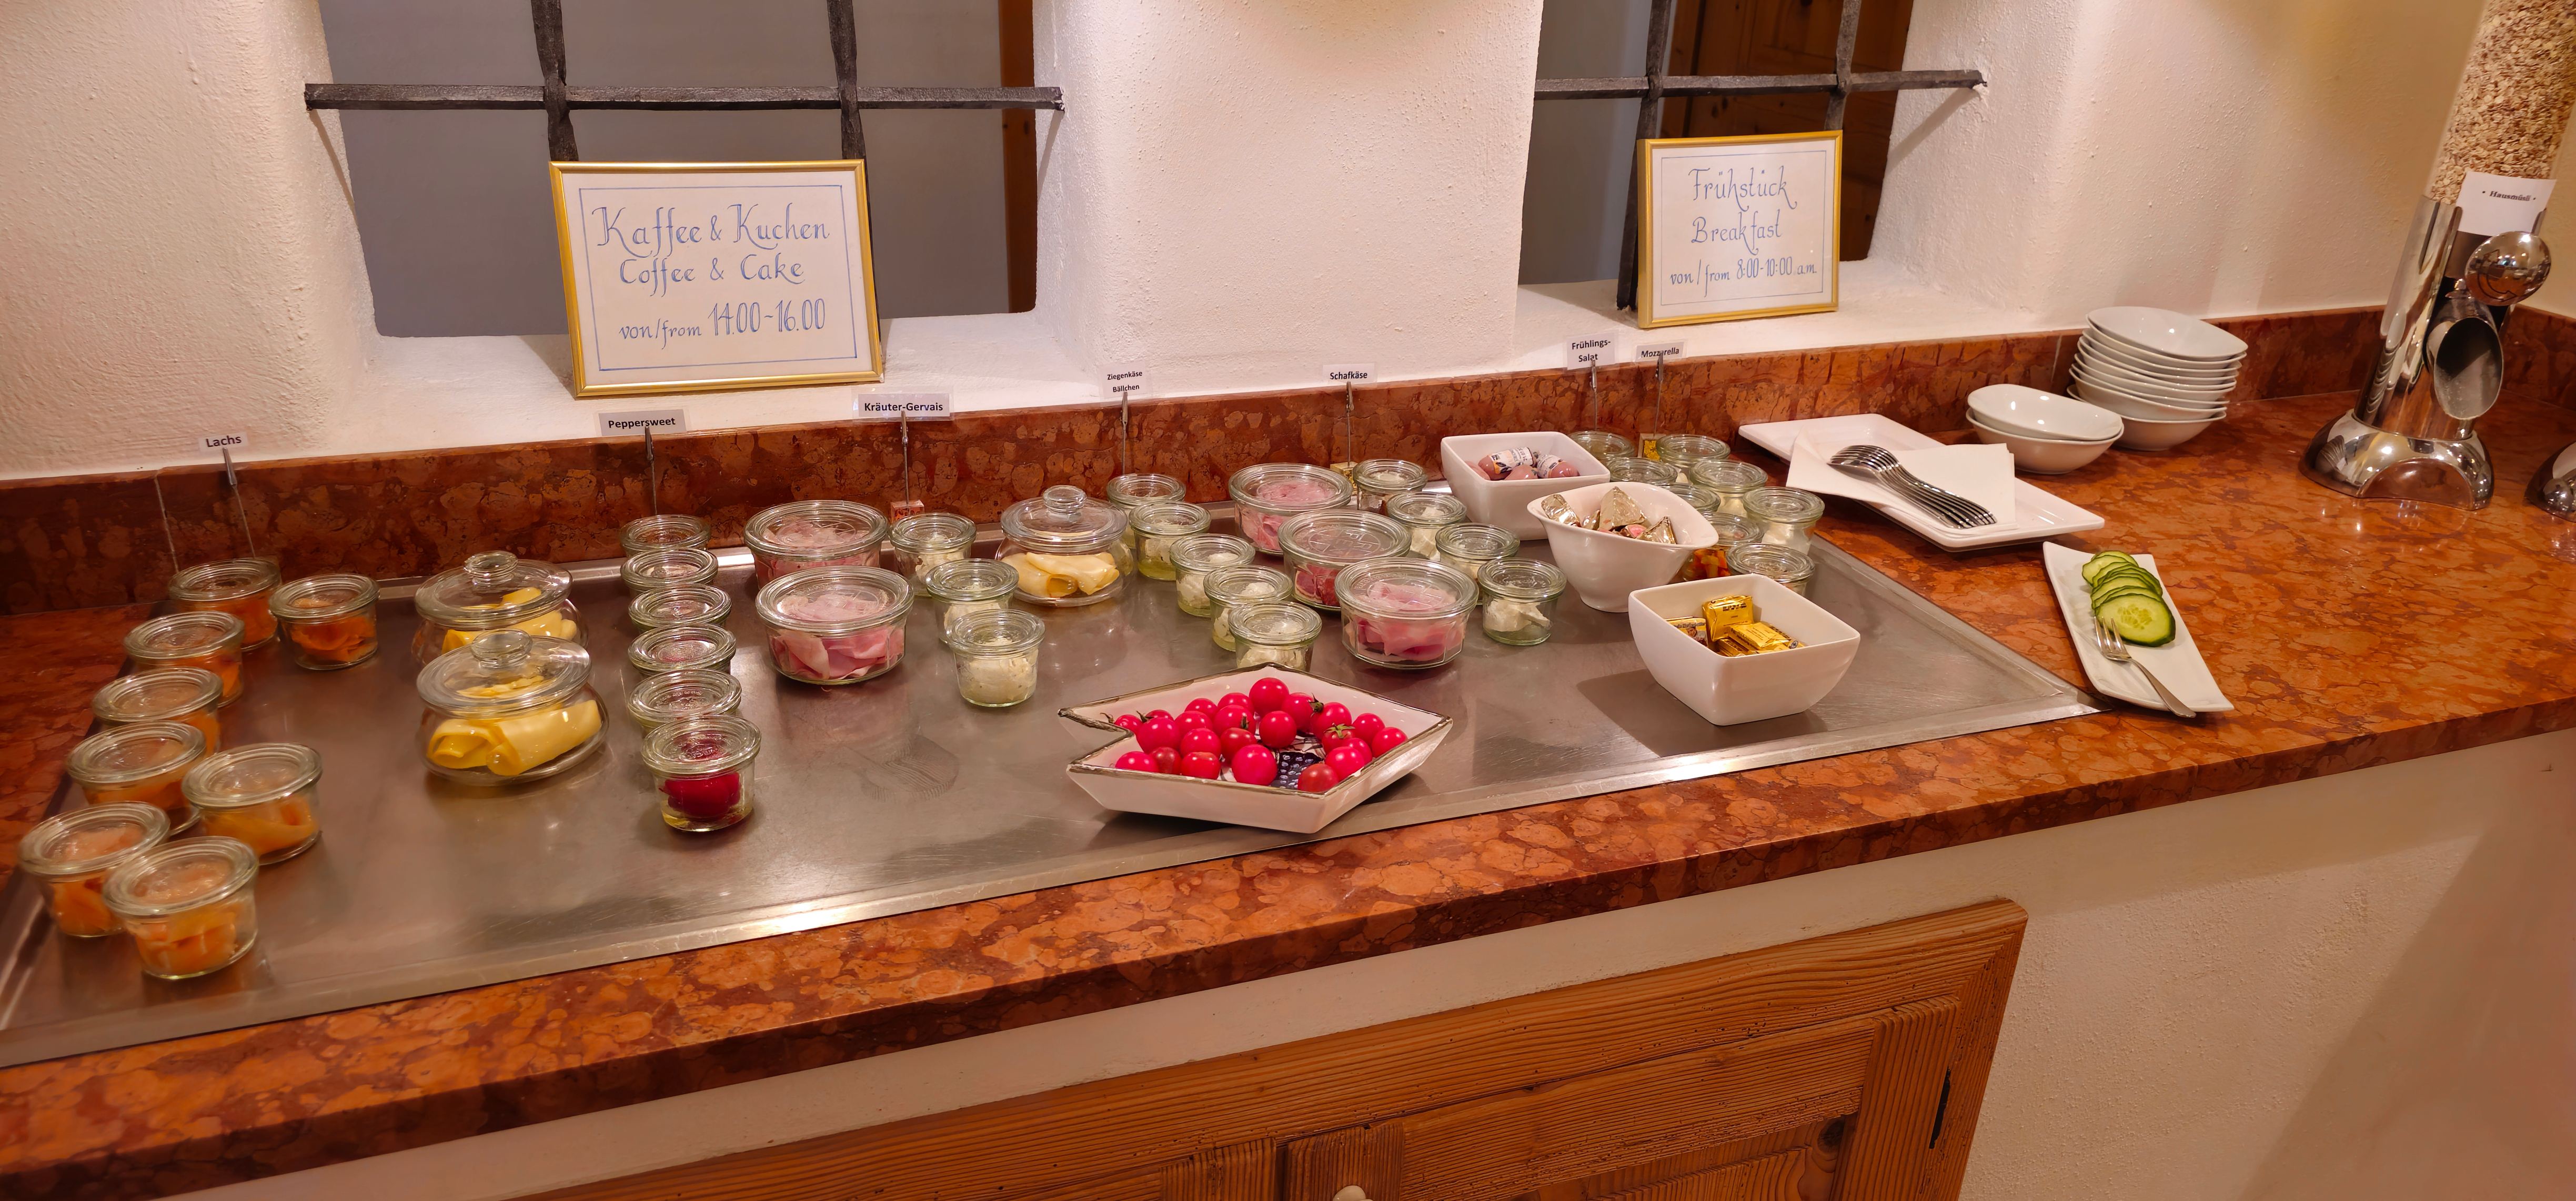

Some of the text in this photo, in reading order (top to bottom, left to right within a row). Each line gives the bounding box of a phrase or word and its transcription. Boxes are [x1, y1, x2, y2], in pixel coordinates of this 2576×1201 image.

[1688, 165, 1797, 211] Frühstück
[2489, 191, 2530, 201] Hausmüsli
[591, 203, 830, 258] Kaffee & Kuchen
[1691, 209, 1783, 256] Breakfast
[619, 253, 806, 297] Coffee & Cake
[619, 319, 702, 349] von/from
[1572, 339, 1611, 350] Frühlings-
[1578, 353, 1598, 362] Salat
[1641, 347, 1679, 357] Mozzrella
[1107, 371, 1143, 380] Ziegenkäse
[1330, 371, 1367, 379] Schafkäse
[864, 402, 943, 411] Kräuter-Gervais
[608, 417, 676, 429] Peppersweet
[206, 435, 242, 447] Lachs
